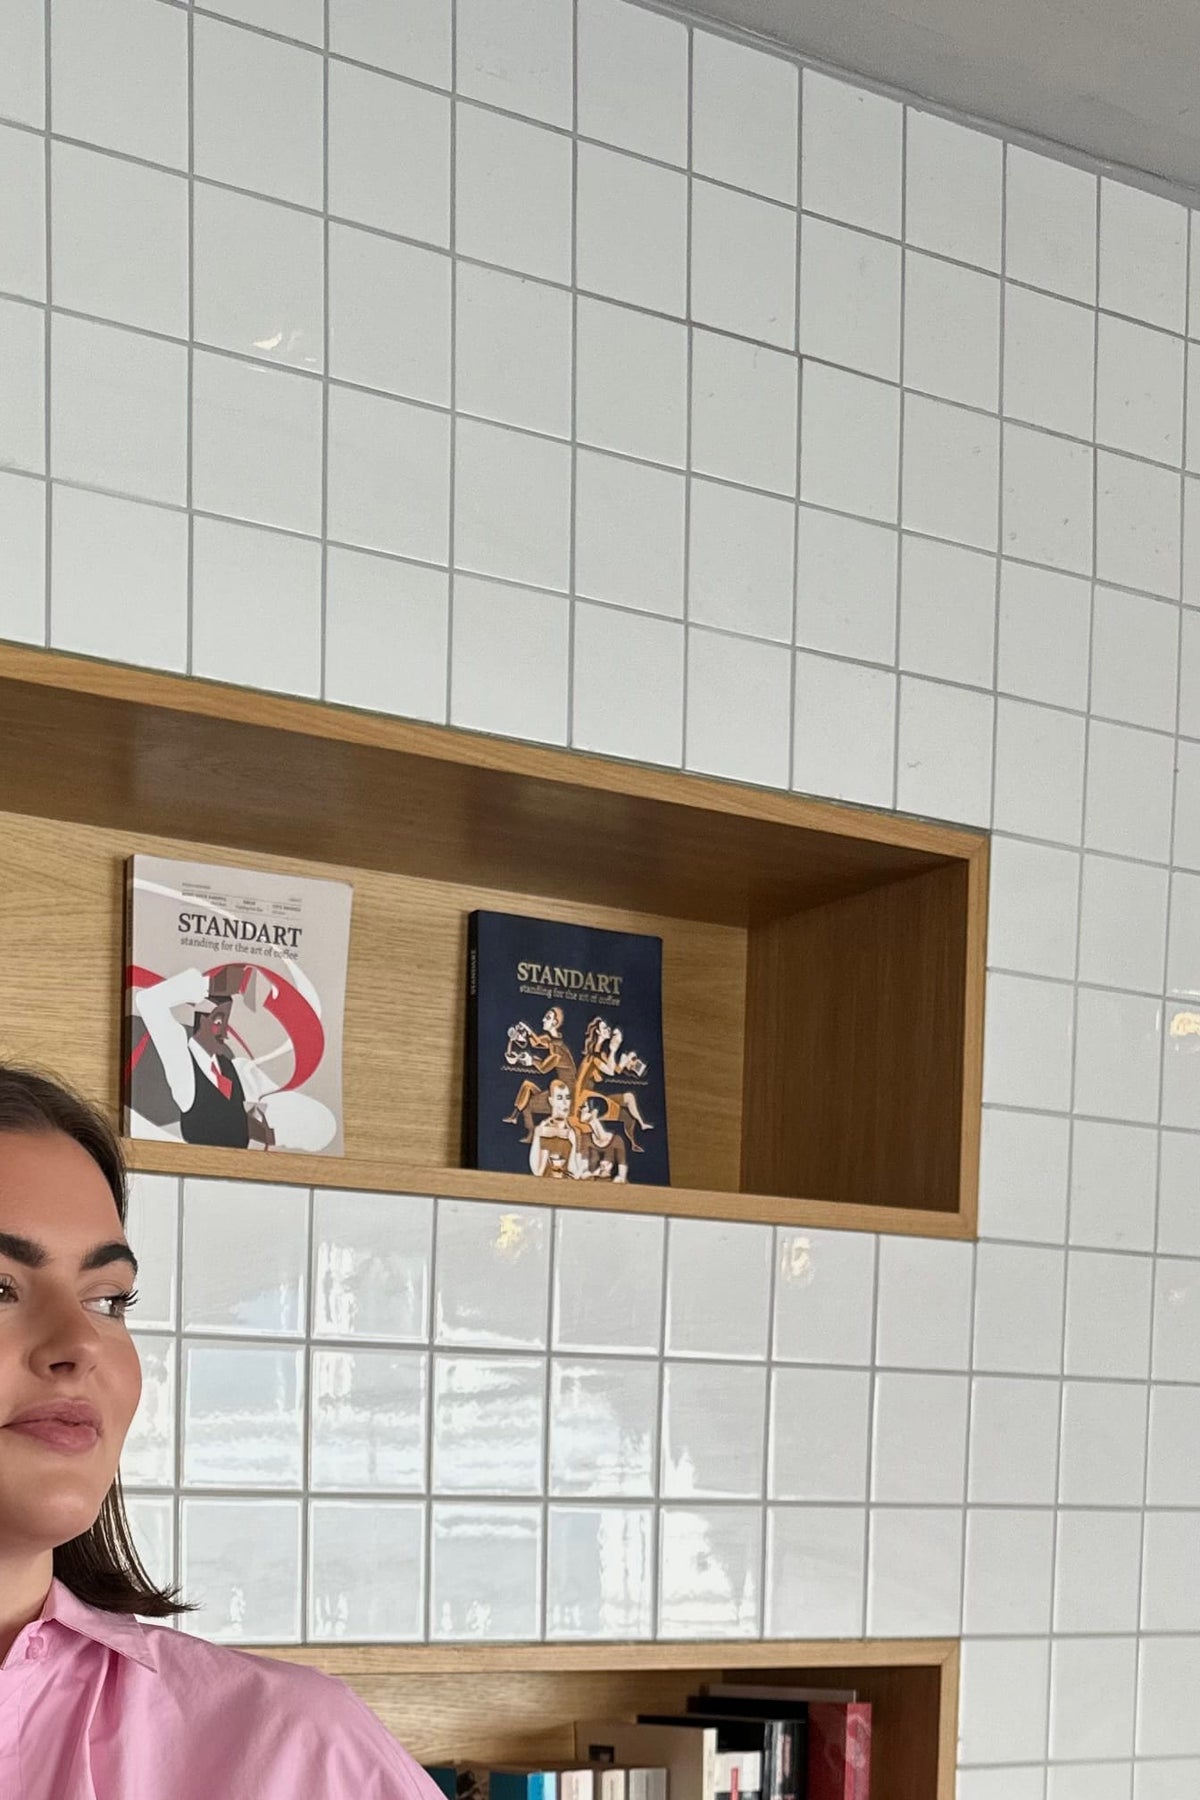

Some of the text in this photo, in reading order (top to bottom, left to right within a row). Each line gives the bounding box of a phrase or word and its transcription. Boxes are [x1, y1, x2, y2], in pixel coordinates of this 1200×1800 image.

[178, 912, 303, 948] STANDART
[180, 937, 220, 952] standing
[221, 940, 234, 951] for
[235, 942, 249, 953] the
[250, 946, 263, 955] art
[264, 947, 274, 957] of
[517, 962, 623, 994] STANDART
